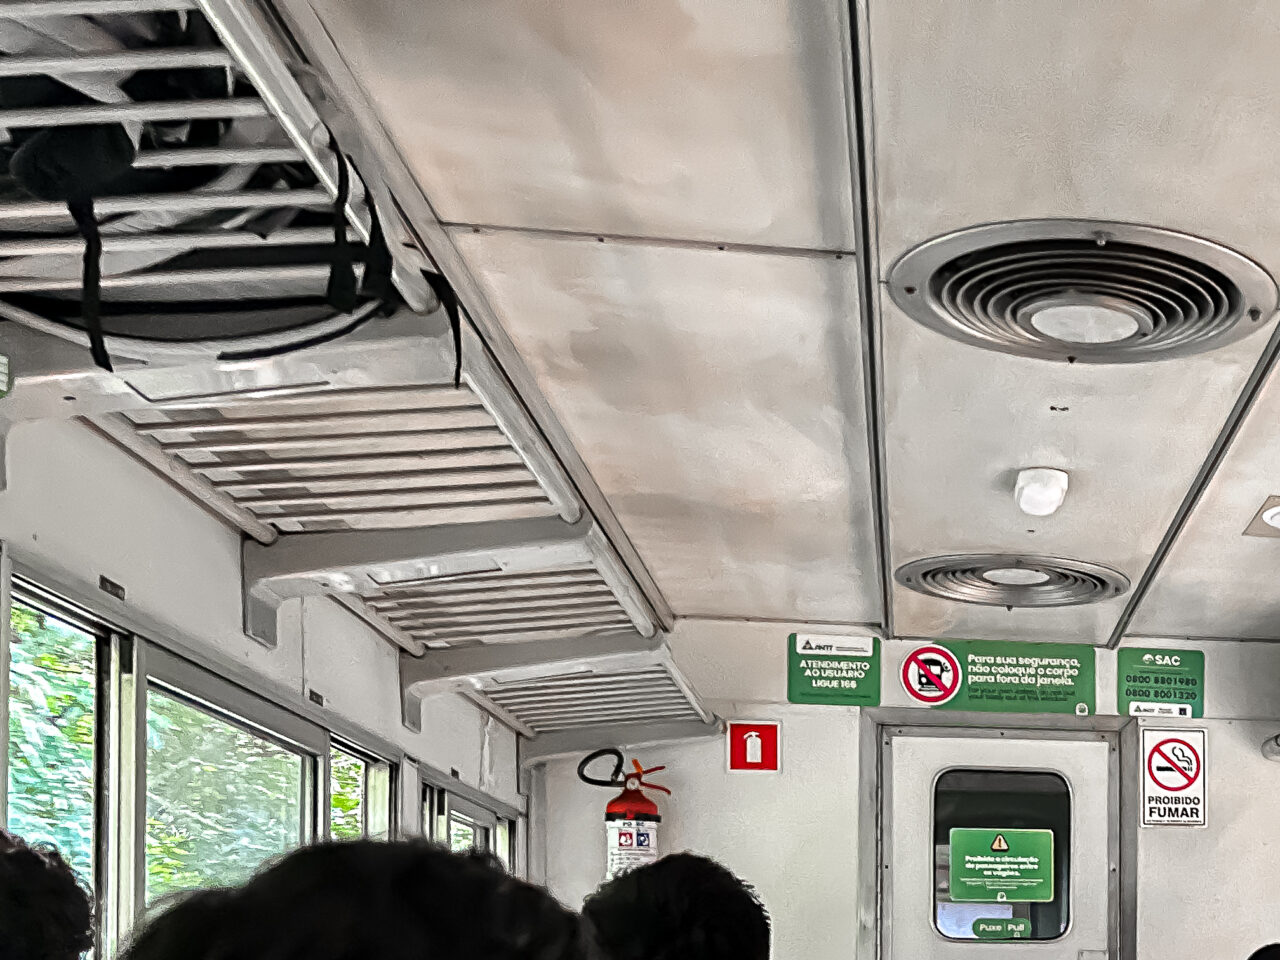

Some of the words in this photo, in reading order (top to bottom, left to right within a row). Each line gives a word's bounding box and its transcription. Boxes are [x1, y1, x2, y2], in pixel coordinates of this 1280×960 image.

[800, 660, 870, 670] ATENDIMENTO
[968, 654, 994, 664] Para
[996, 656, 1017, 665] sua
[1018, 657, 1081, 668] segurança,
[1155, 654, 1181, 666] SAC
[804, 668, 820, 677] AO
[967, 663, 990, 673] não
[991, 665, 1036, 676] coloque
[1037, 667, 1045, 675] o
[1046, 667, 1079, 678] corpo
[812, 679, 839, 688] LIGUE
[967, 674, 995, 685] para
[996, 674, 1019, 684] fora
[1020, 675, 1035, 684] da
[1036, 675, 1075, 687] janela.
[1125, 674, 1151, 684] 0800
[1125, 689, 1151, 698] 0800
[1148, 795, 1201, 805] PROIBIDO
[1149, 806, 1200, 818] FUMAR
[979, 923, 1002, 931] Puxe
[1007, 923, 1025, 931] Pull
